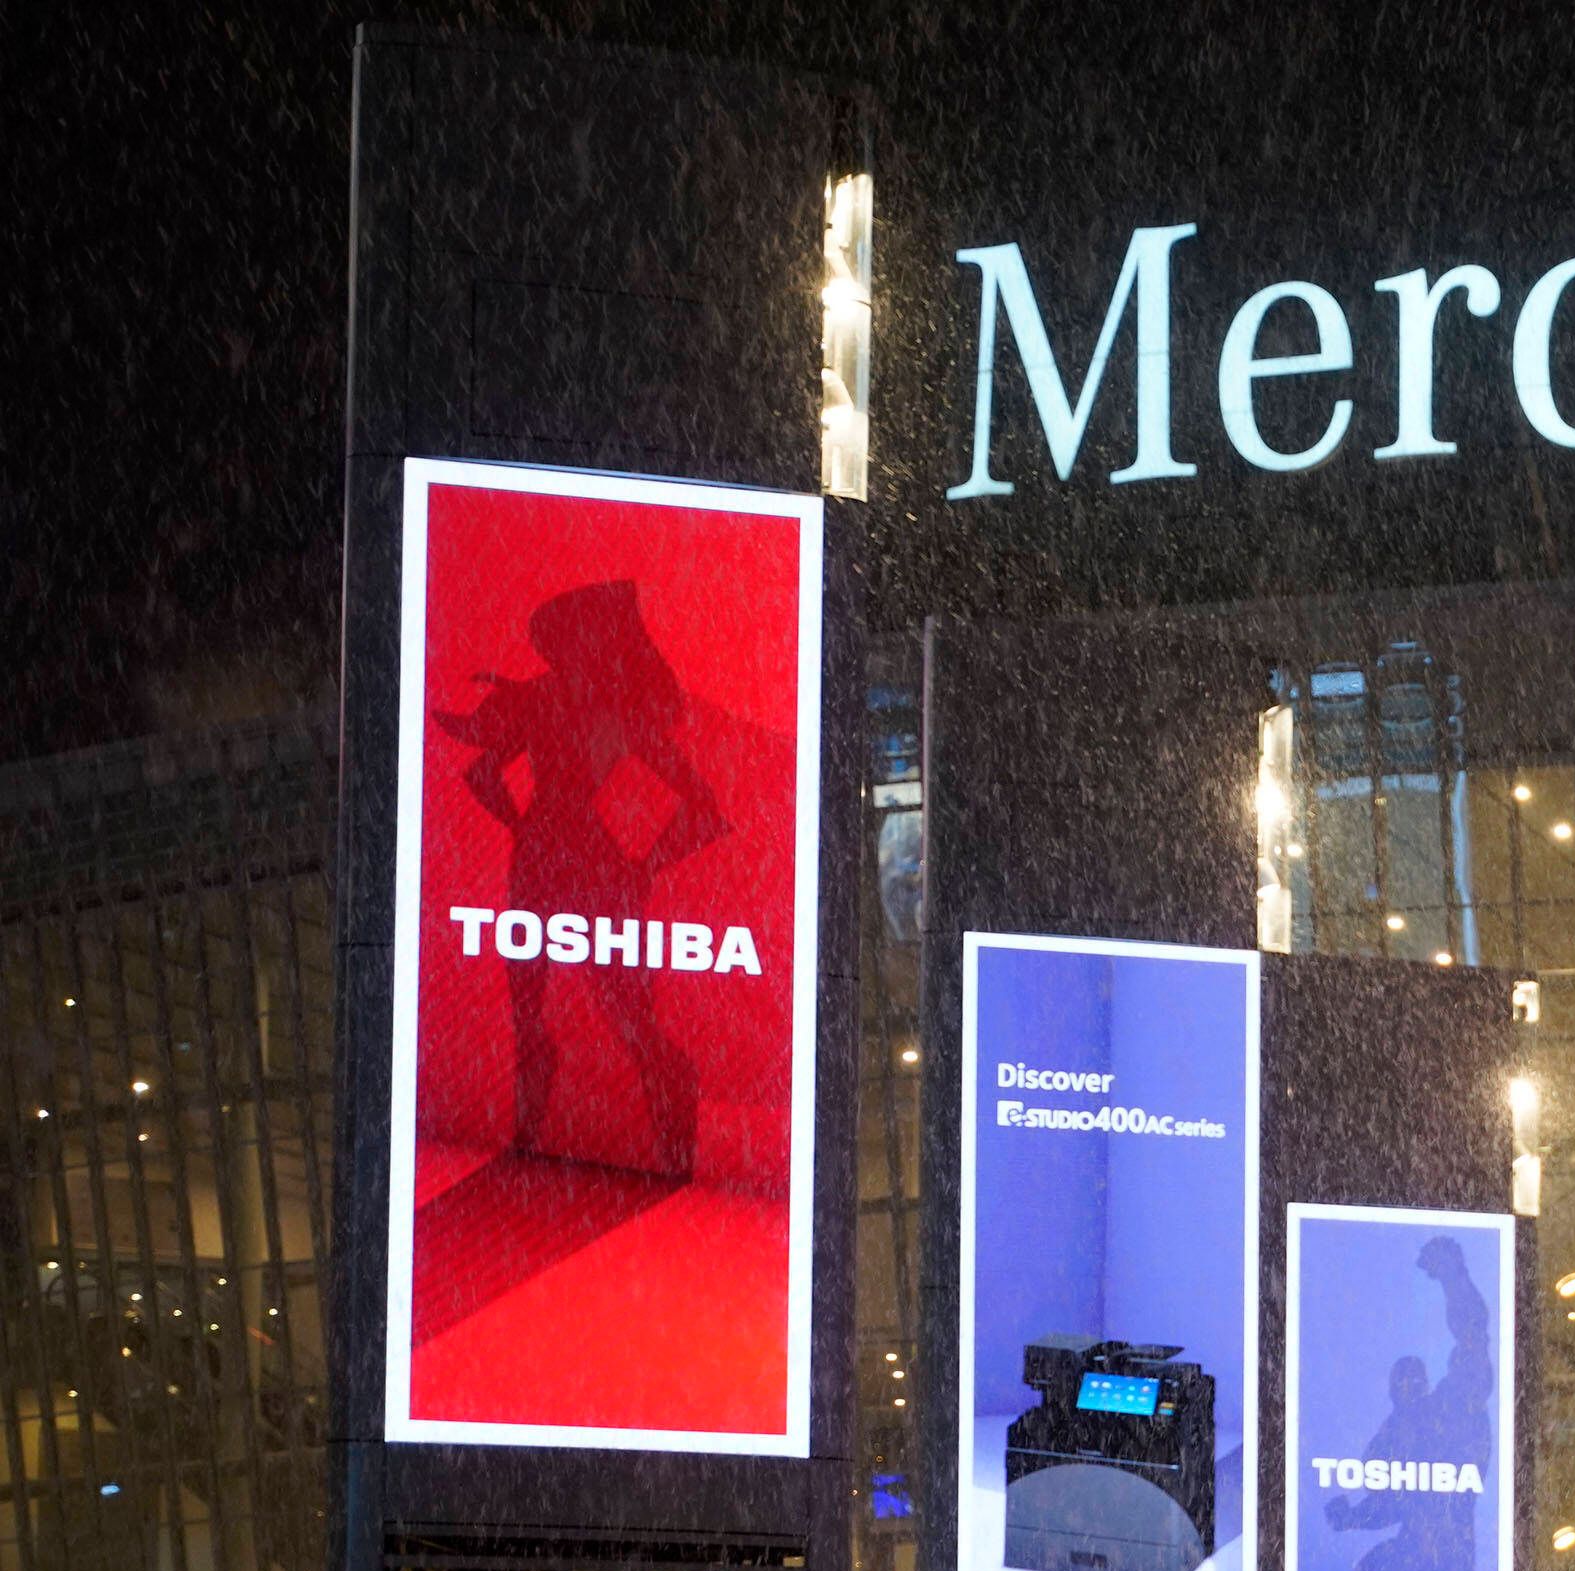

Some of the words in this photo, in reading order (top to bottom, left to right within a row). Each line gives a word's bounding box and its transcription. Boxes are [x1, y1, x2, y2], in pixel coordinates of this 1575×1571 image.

[448, 905, 763, 977] TOSHIBA
[996, 1061, 1116, 1094] Discover
[1175, 1117, 1227, 1139] series
[1310, 1456, 1485, 1495] TOSHIBA
